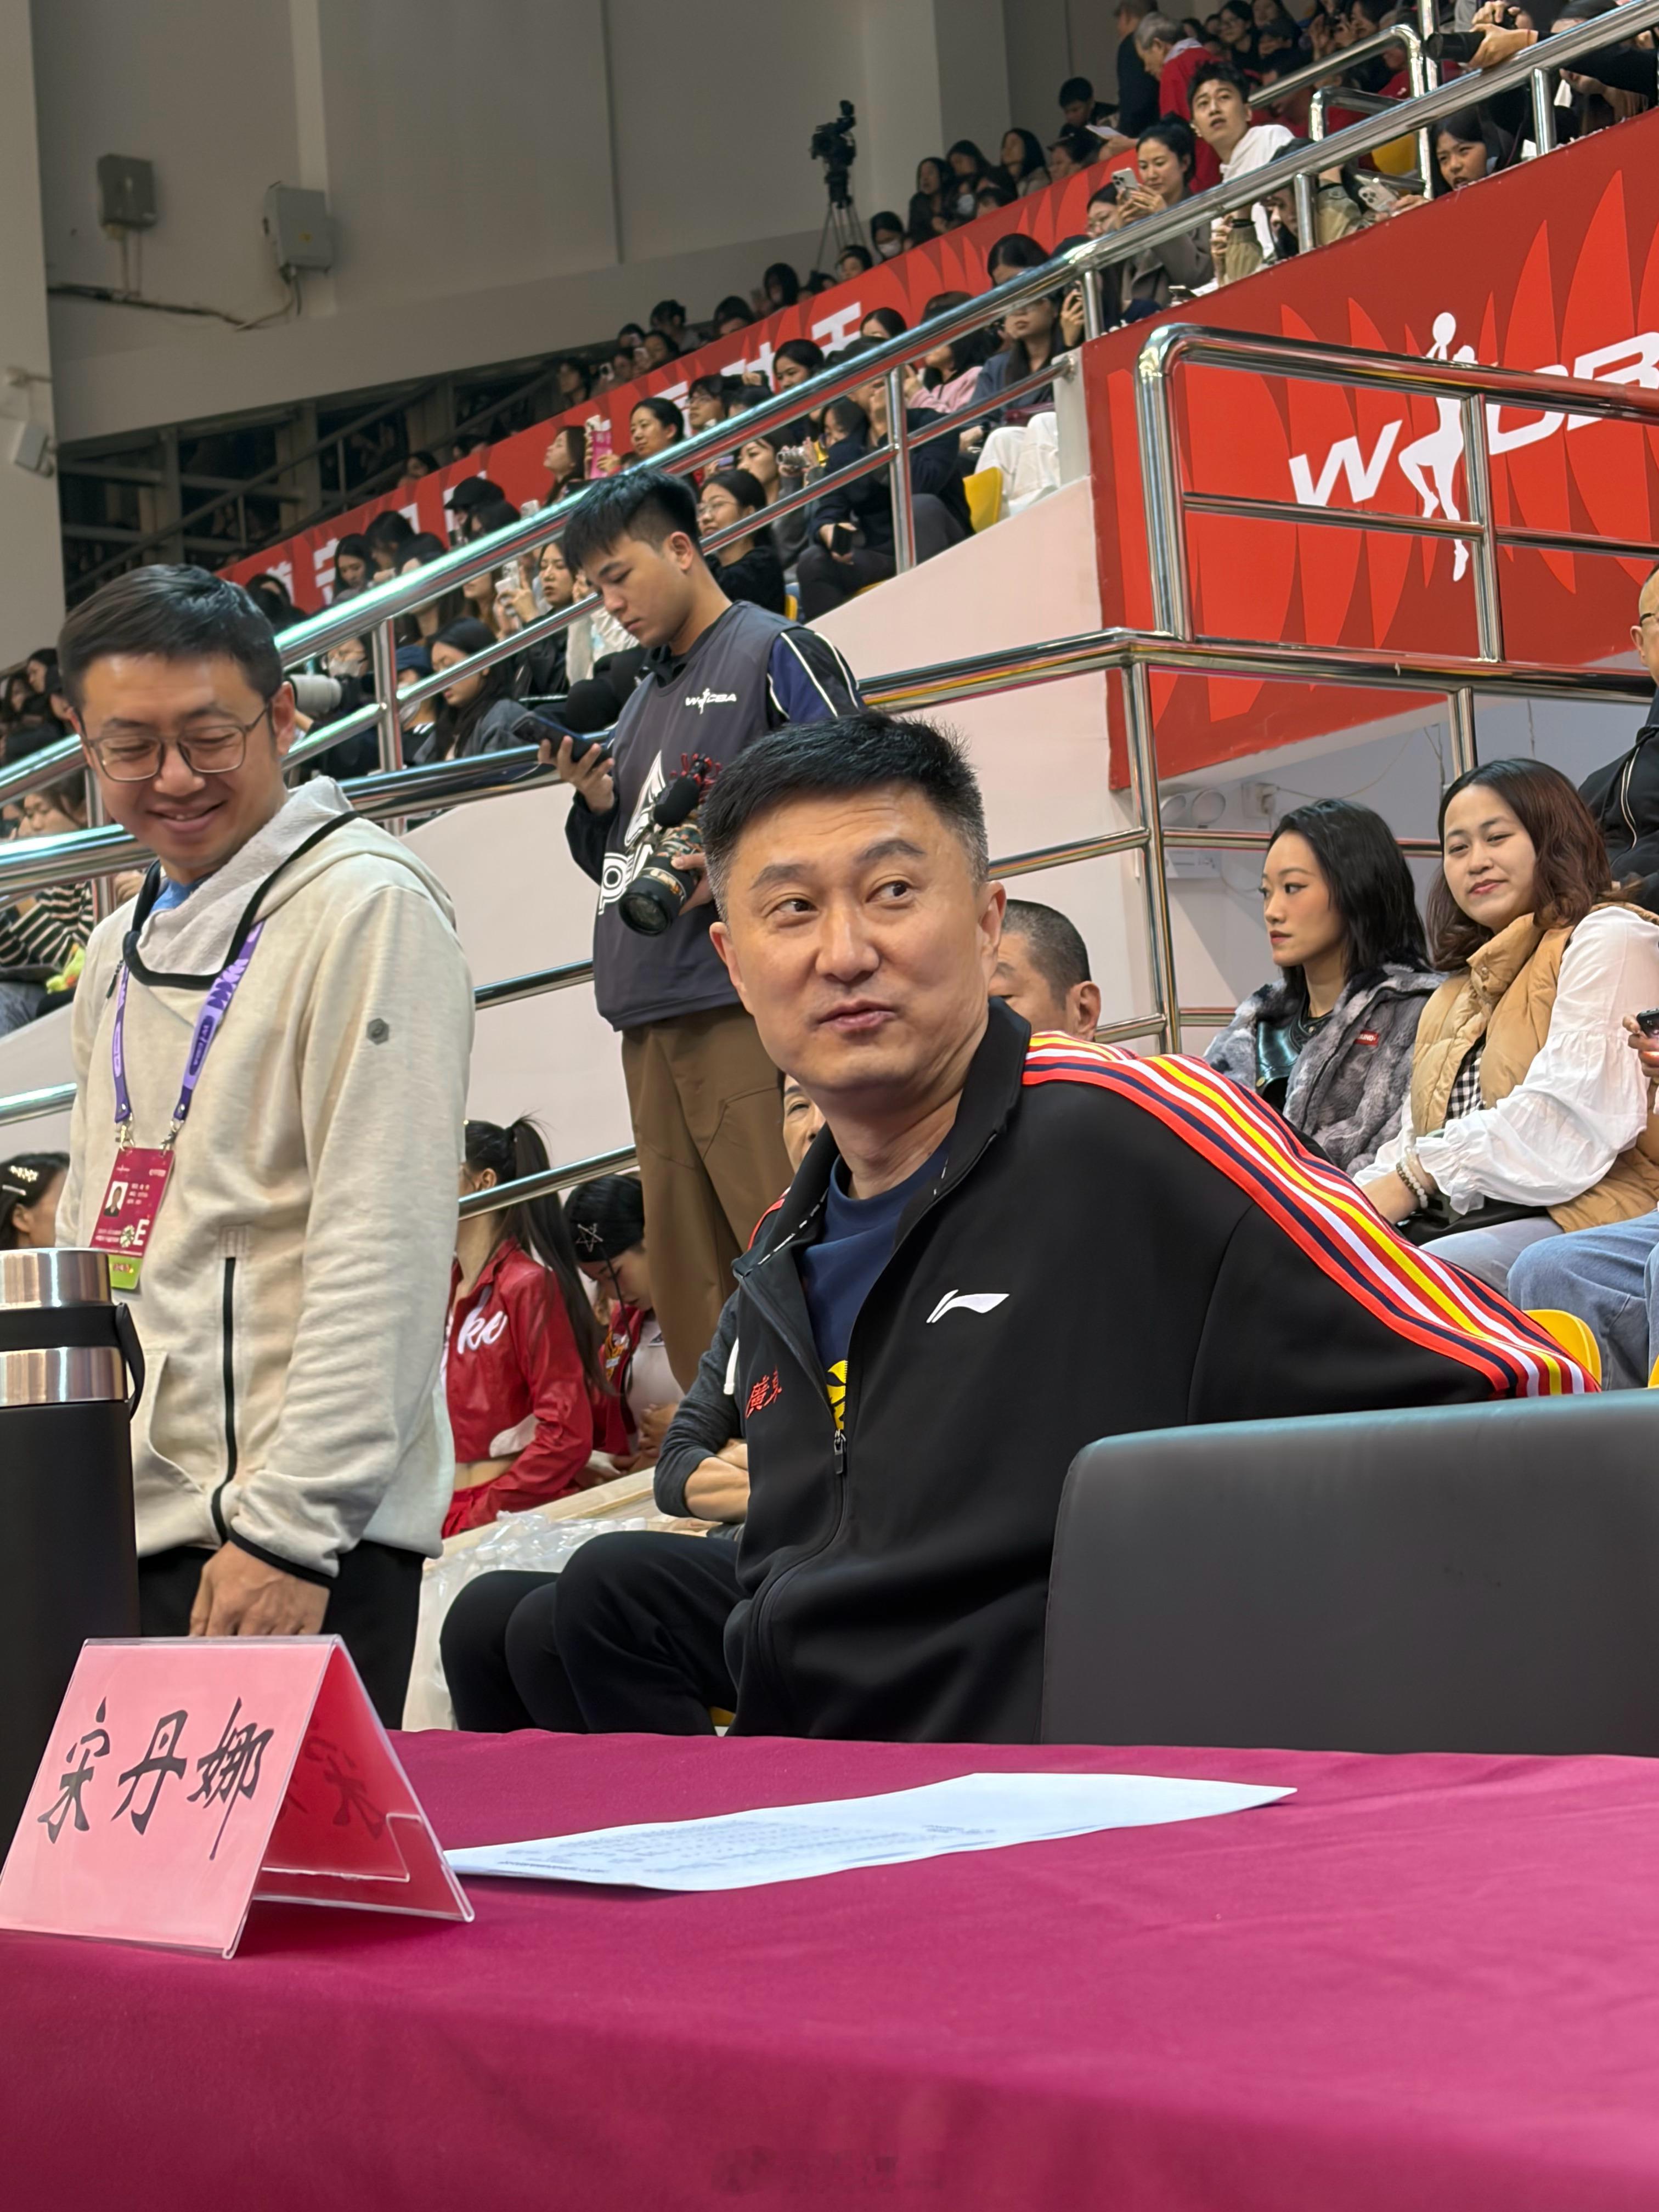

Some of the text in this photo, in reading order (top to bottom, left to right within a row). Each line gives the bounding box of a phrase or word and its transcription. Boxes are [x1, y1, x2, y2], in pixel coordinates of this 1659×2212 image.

[685, 692, 737, 707] WCBA
[37, 1696, 274, 1860] 宋丹娜
